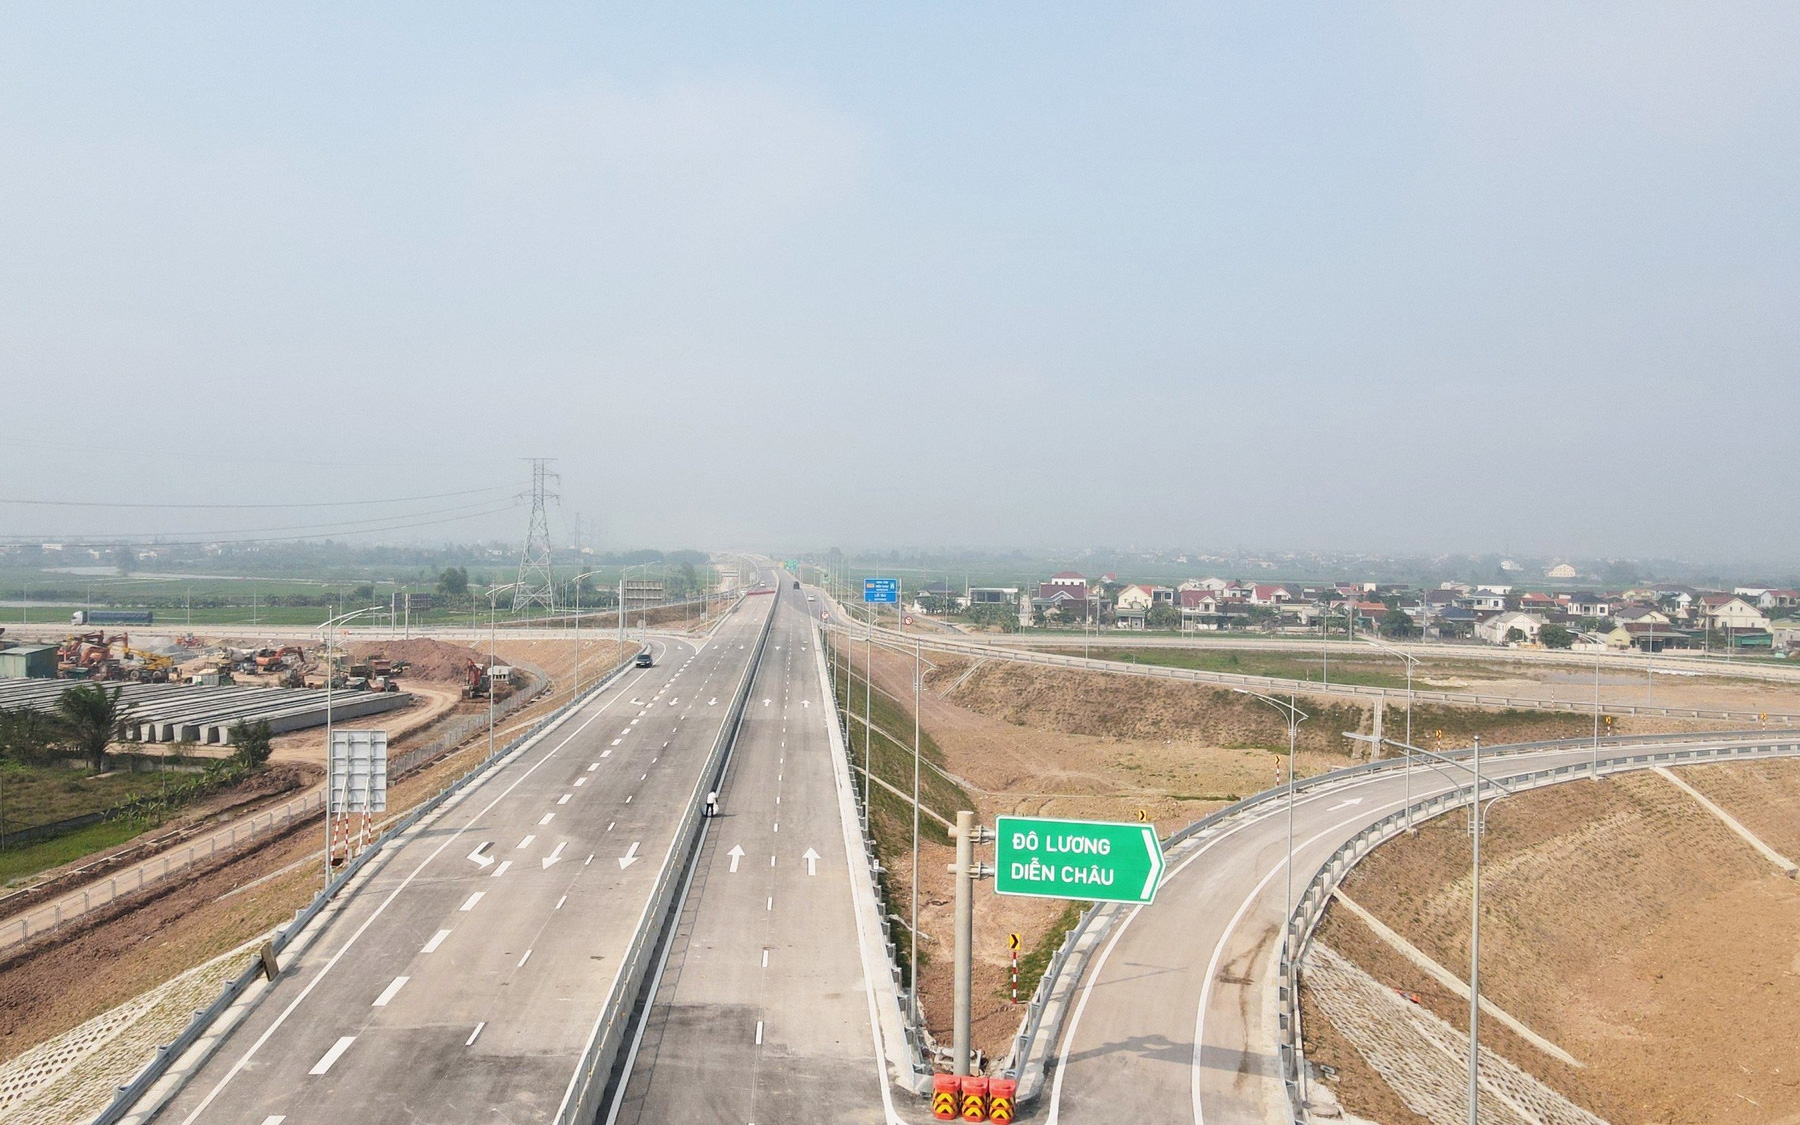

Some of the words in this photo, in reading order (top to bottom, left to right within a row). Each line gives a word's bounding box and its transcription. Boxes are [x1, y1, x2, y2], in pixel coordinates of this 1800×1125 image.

[1012, 831, 1039, 850] ĐÔ
[1046, 835, 1111, 855] LƯƠNG
[1011, 857, 1055, 881] DIỄN
[1061, 865, 1114, 886] CHÂU
